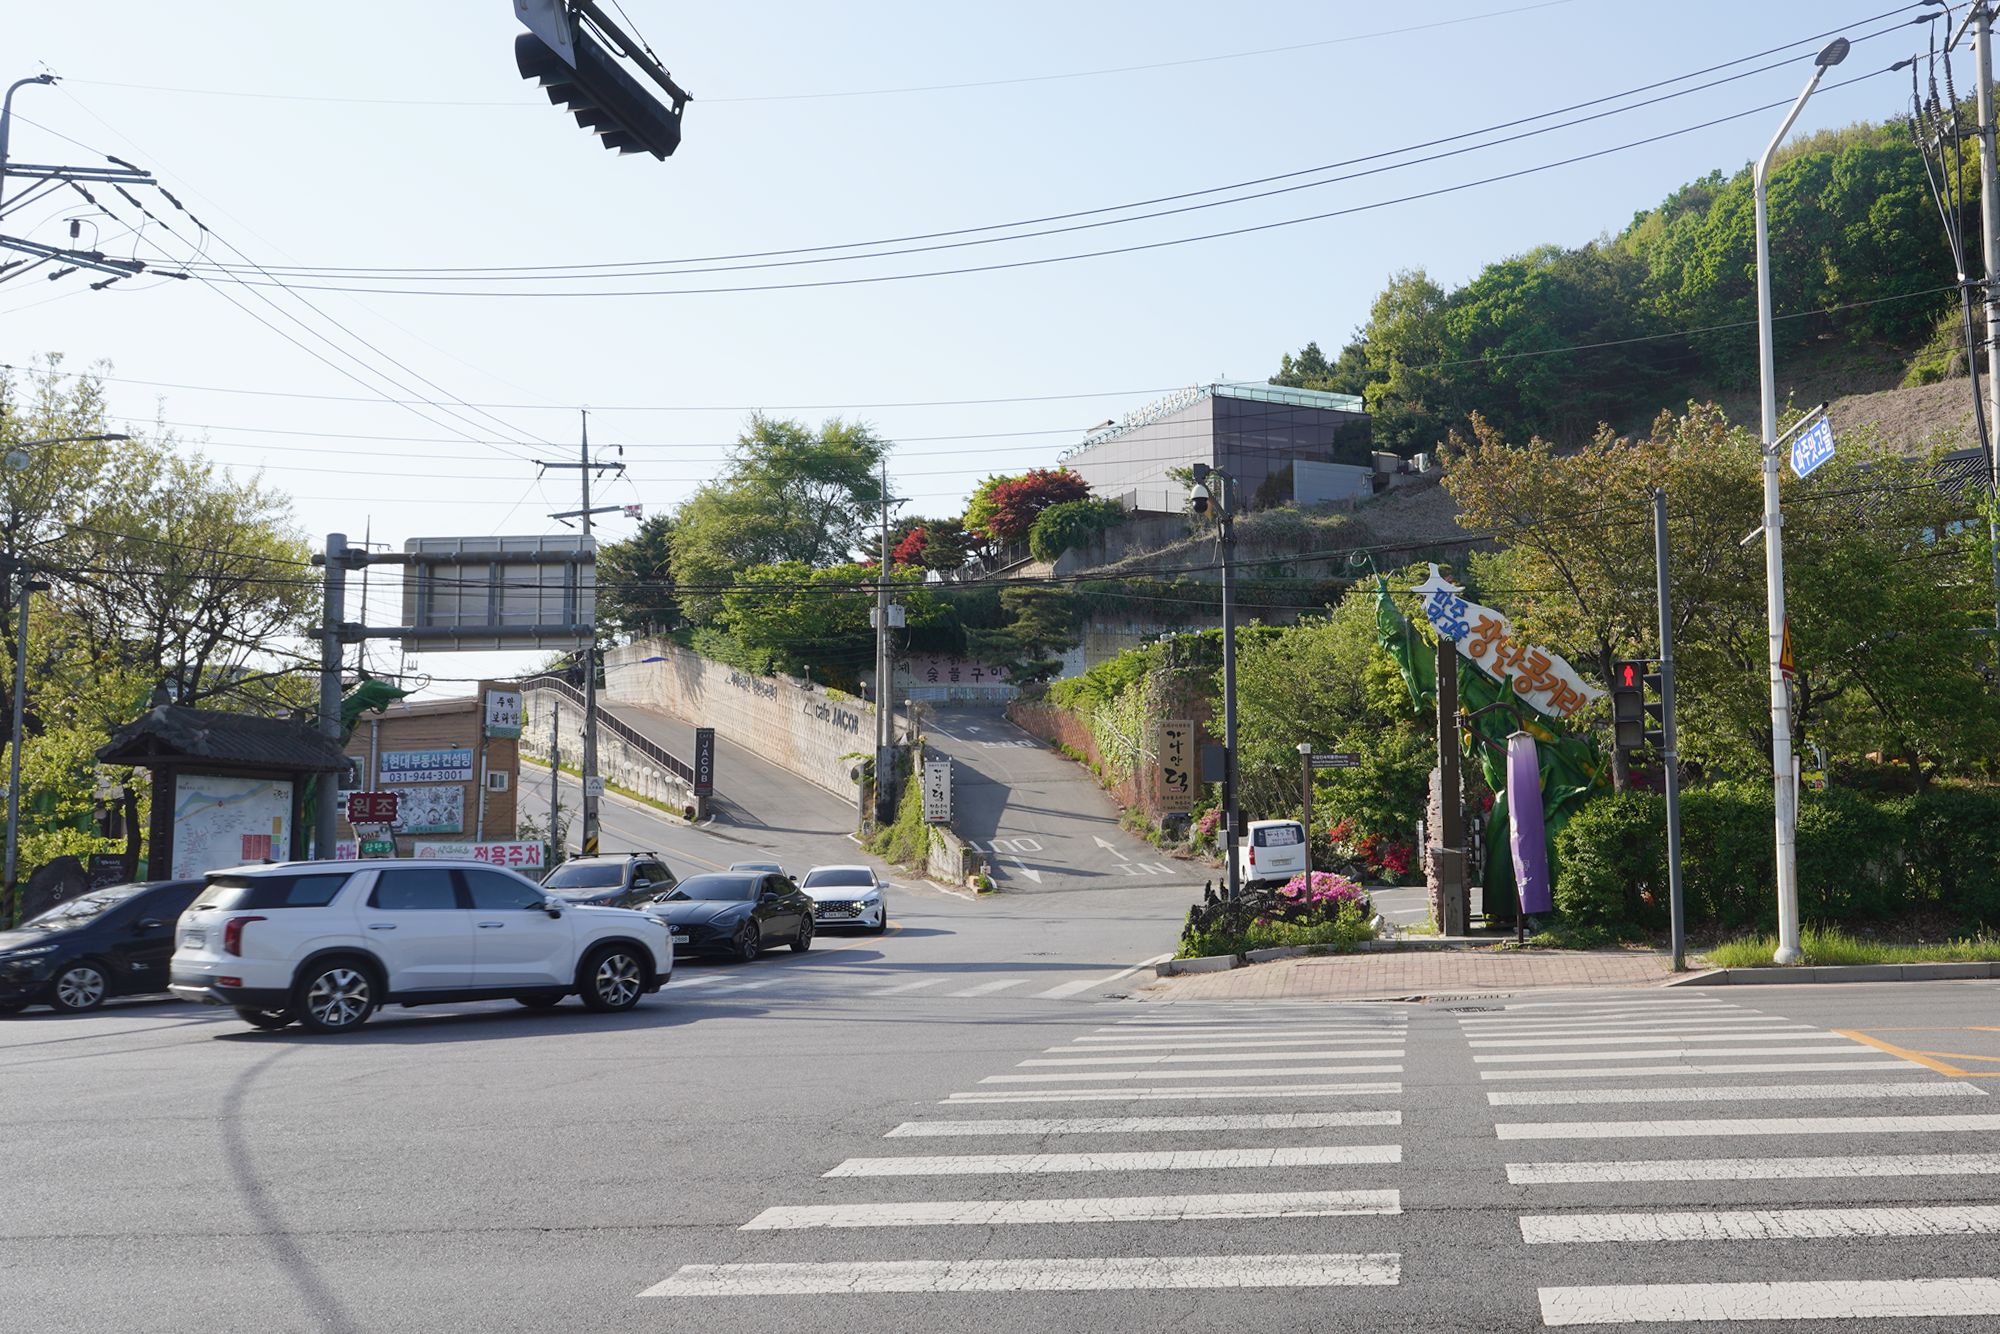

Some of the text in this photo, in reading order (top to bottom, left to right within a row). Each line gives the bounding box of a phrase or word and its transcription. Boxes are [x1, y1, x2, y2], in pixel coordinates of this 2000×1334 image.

[1795, 424, 1832, 470] 파주맛고을
[1433, 587, 1469, 619] 파주
[1468, 613, 1588, 720] 장단콩거리
[815, 702, 859, 735] cafe JACOB
[389, 770, 463, 782] 031-944-3001
[701, 740, 709, 782] JACOB
[353, 797, 395, 818] 원조
[1111, 862, 1177, 876] IN
